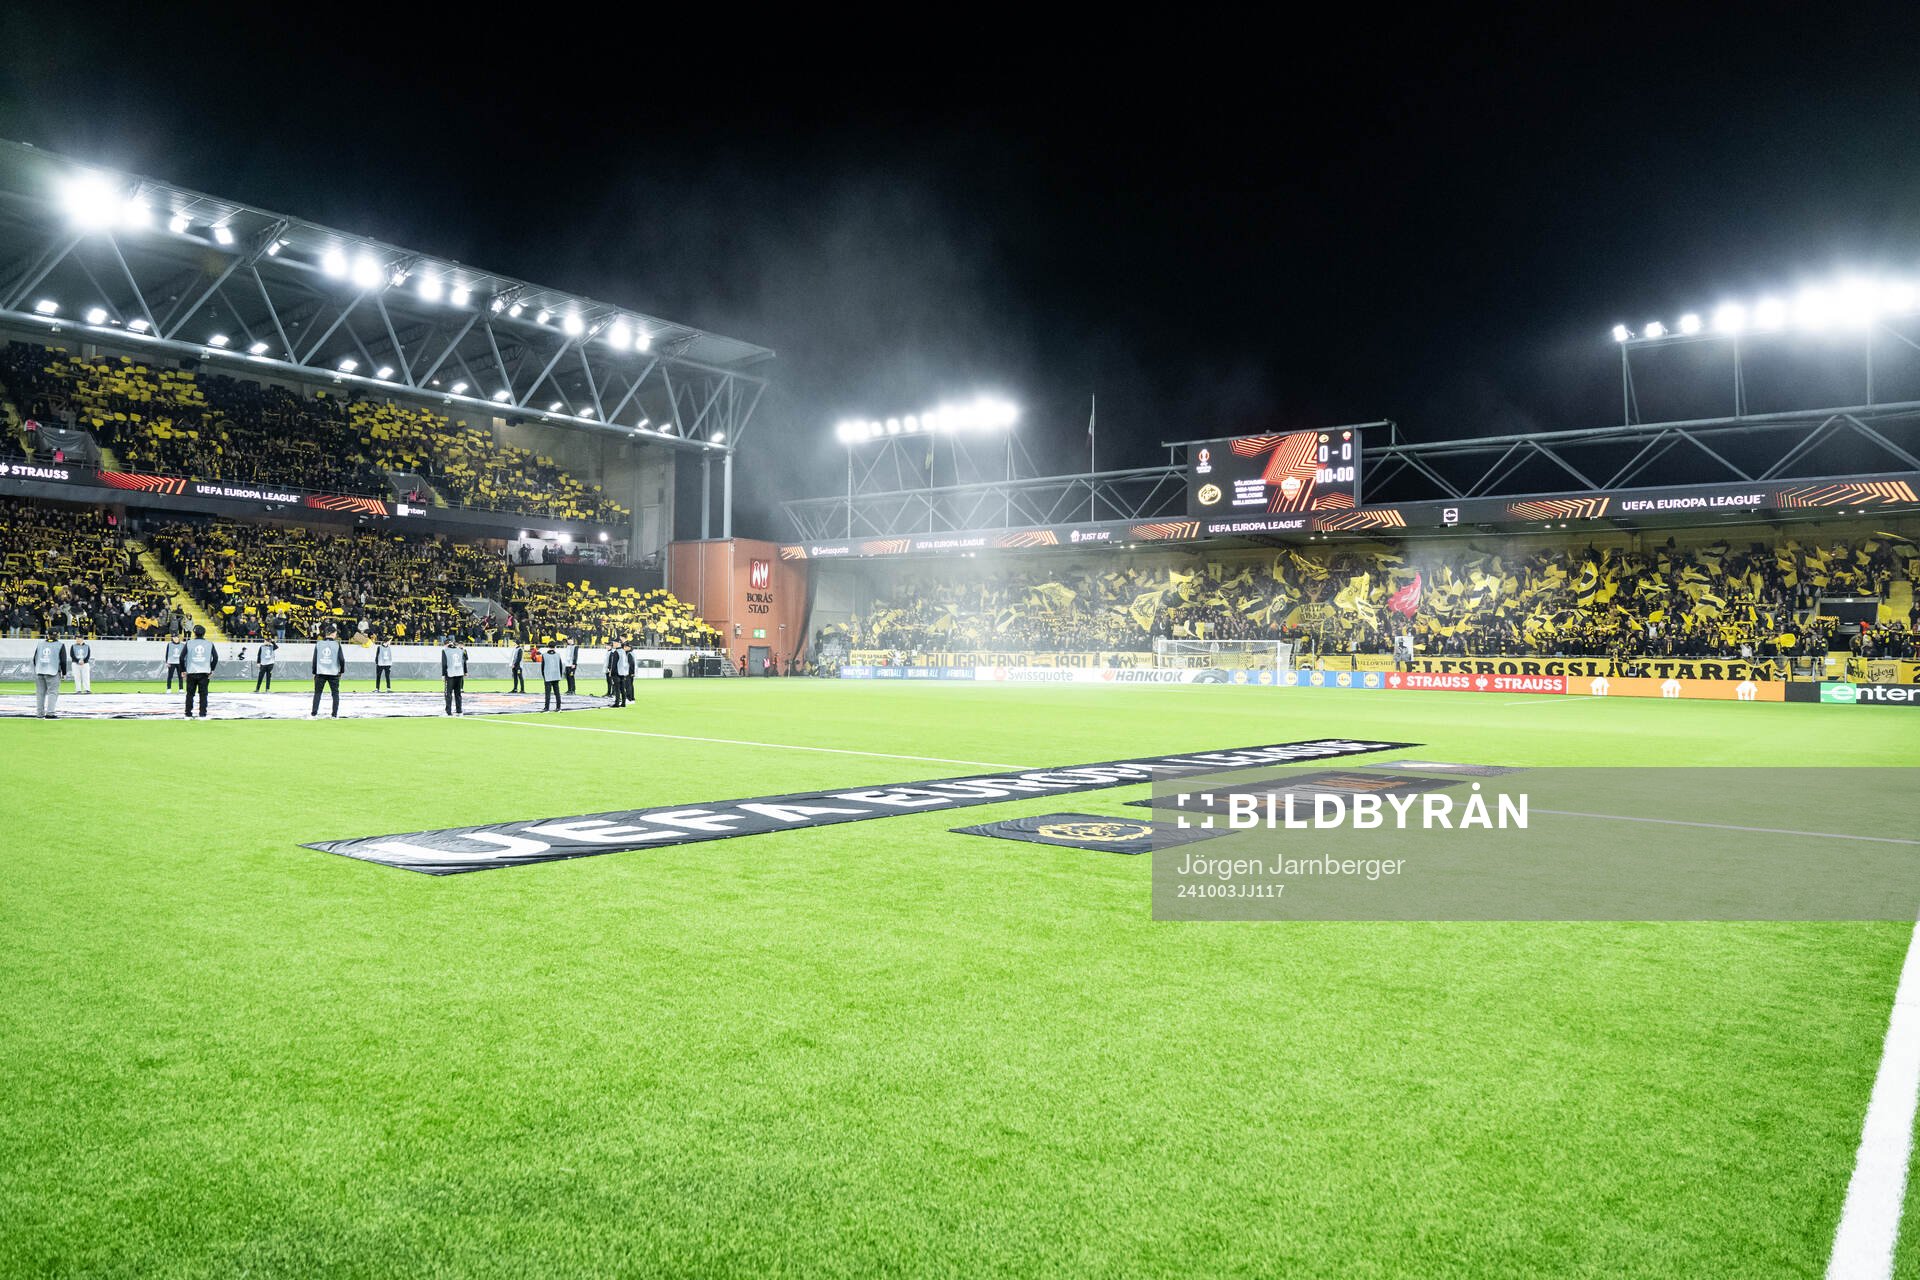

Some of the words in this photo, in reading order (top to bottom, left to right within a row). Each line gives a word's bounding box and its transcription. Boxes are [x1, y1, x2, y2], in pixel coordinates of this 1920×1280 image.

[11, 465, 69, 480] STRAUSS
[196, 485, 223, 496] UEFA
[224, 488, 261, 499] EUROPA
[262, 491, 298, 503] LEAGUE
[1622, 500, 1655, 511] UEFA
[1657, 497, 1707, 509] EUROPA
[1709, 494, 1761, 507] LEAGUE
[1208, 524, 1231, 533] UEFA
[1232, 522, 1267, 531] EUROPA
[1267, 520, 1303, 530] LEAGUE
[1080, 532, 1097, 541] JUST
[1097, 532, 1111, 540] EAT
[916, 541, 933, 549] UEFA
[933, 540, 959, 548] EUROPA
[746, 592, 773, 603] BORÅS
[748, 604, 769, 614] STAD
[1055, 655, 1087, 668] 1991
[1007, 667, 1073, 682] Swissquote
[1406, 675, 1470, 688] STRAUSS
[1494, 678, 1563, 691] STRAUSS
[1829, 685, 1920, 701] enter
[364, 801, 874, 862] UEFA
[826, 763, 1214, 807] EUROPA
